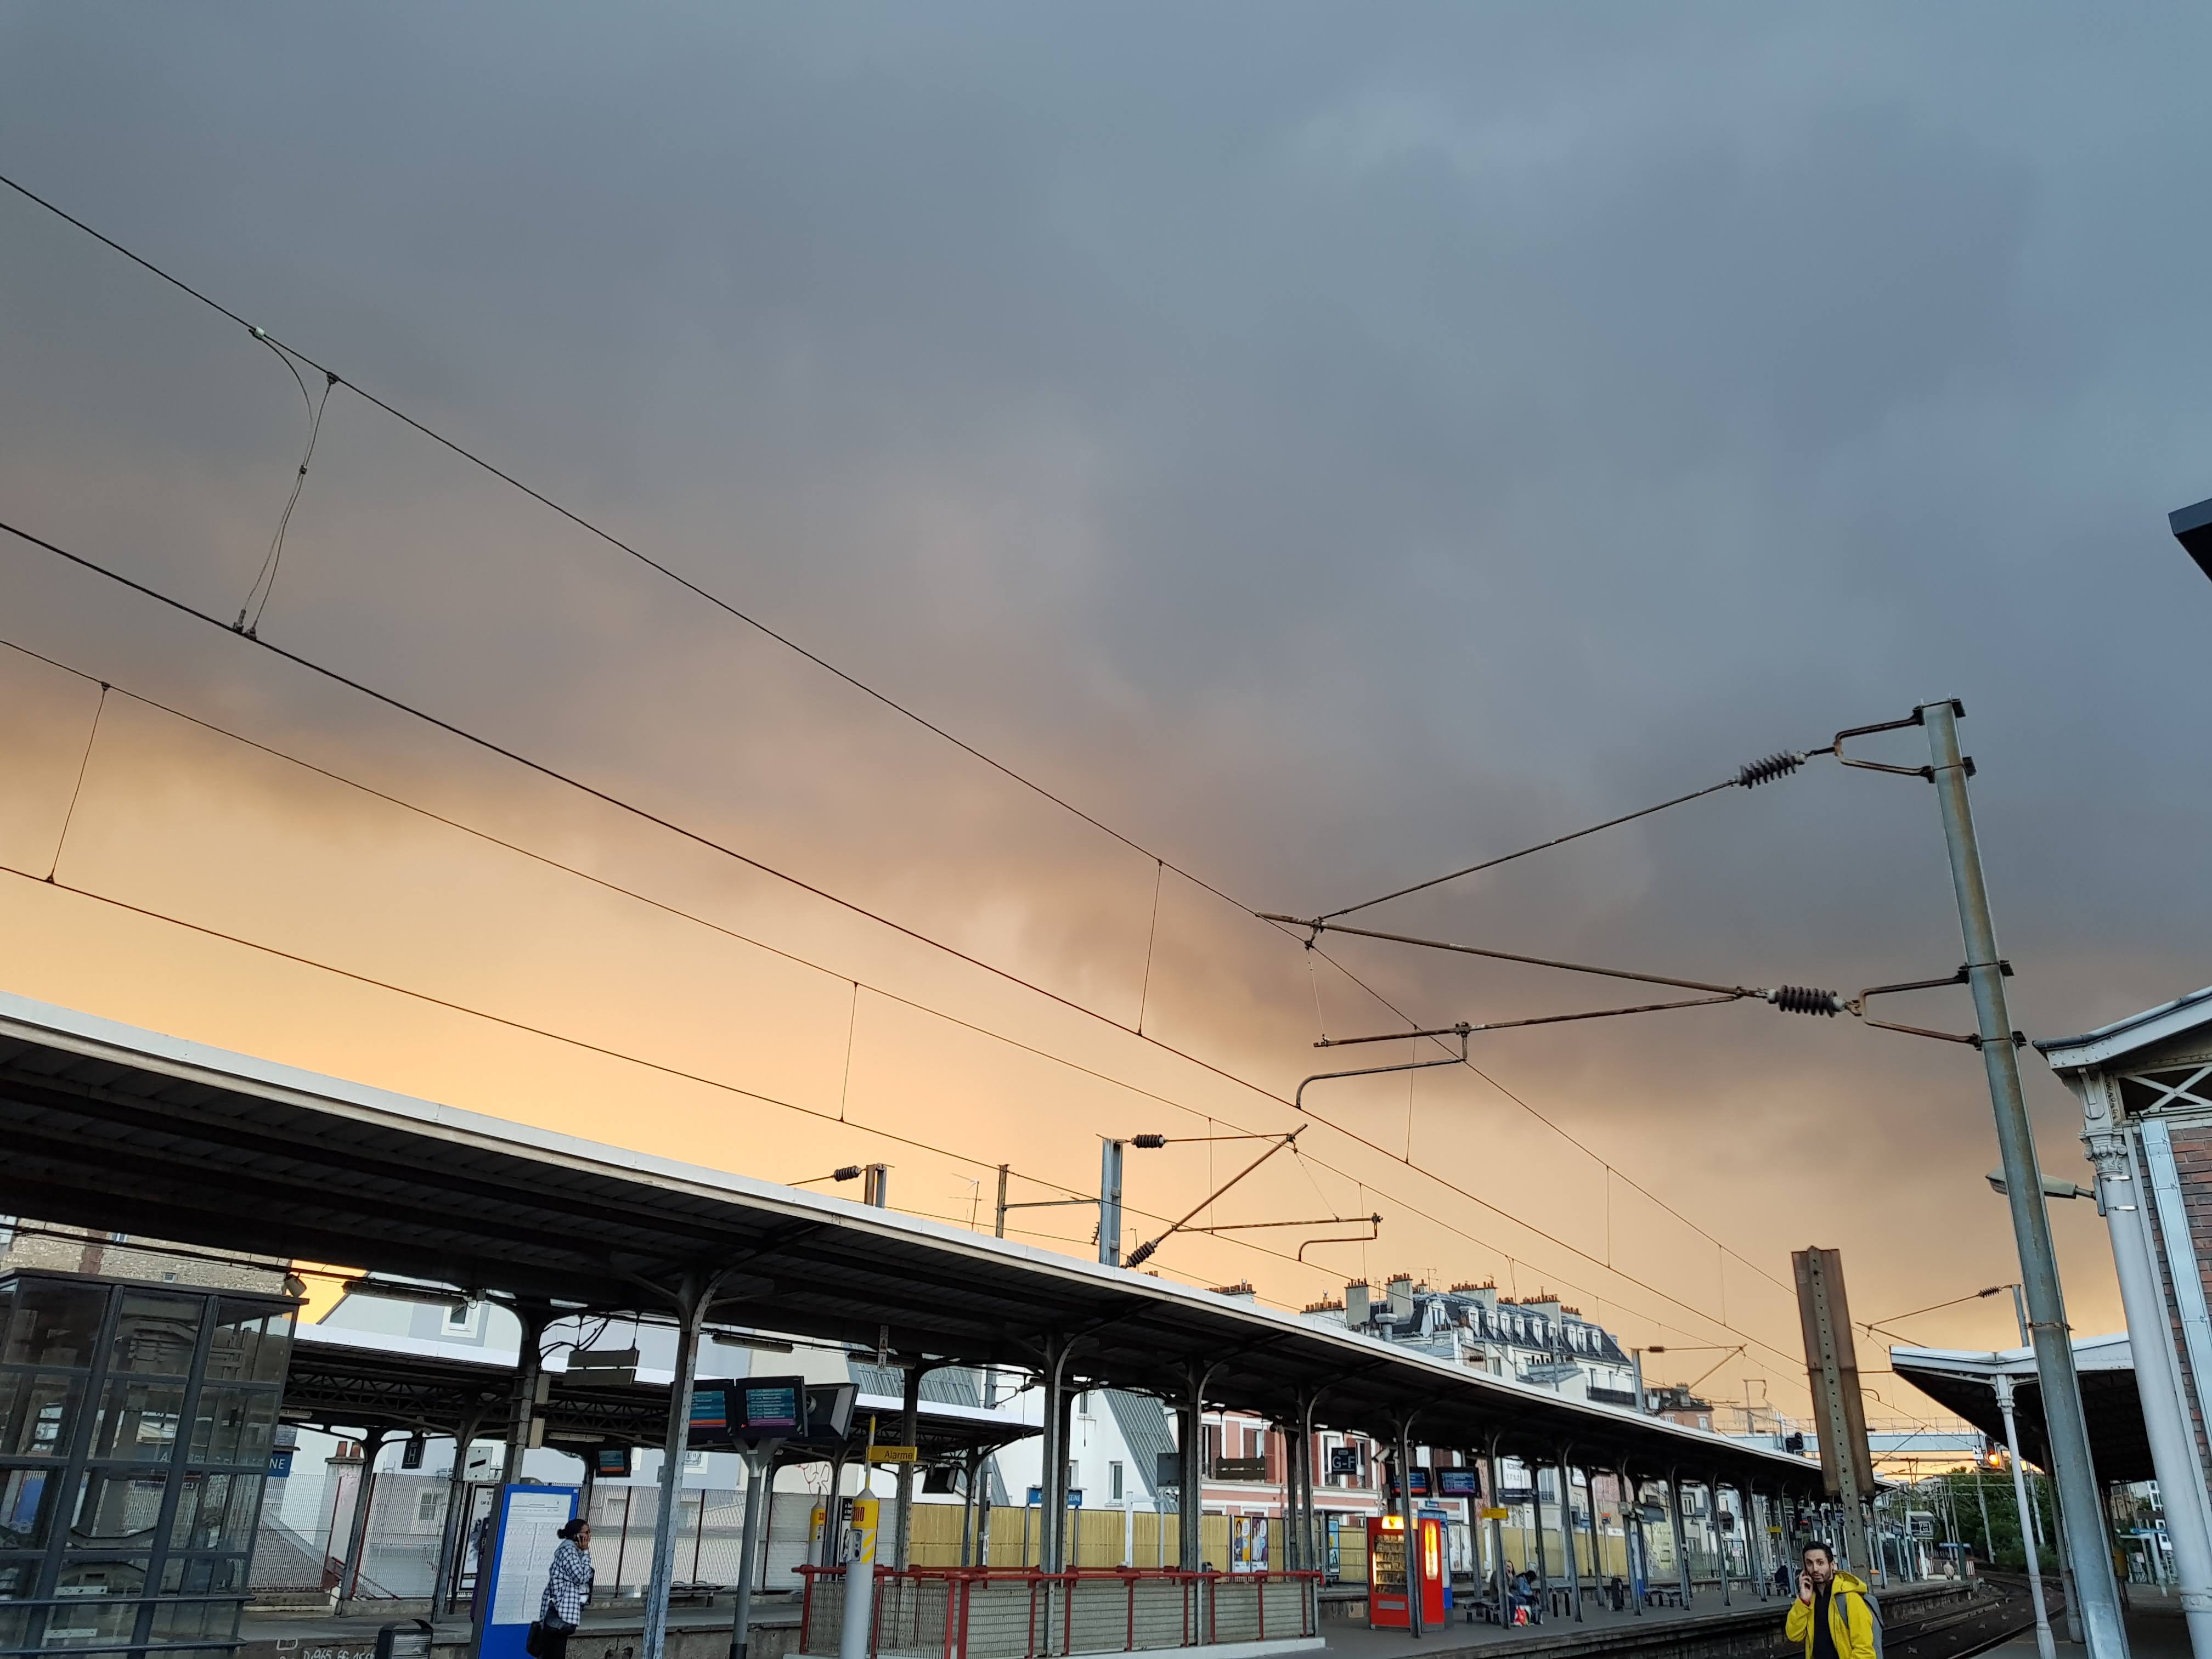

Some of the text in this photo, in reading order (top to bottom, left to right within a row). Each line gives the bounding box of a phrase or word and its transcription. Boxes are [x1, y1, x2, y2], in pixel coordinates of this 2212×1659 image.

[884, 1450, 913, 1459] Alarme
[1332, 1456, 1355, 1469] G-F
[1068, 1494, 1080, 1502] SEINE
